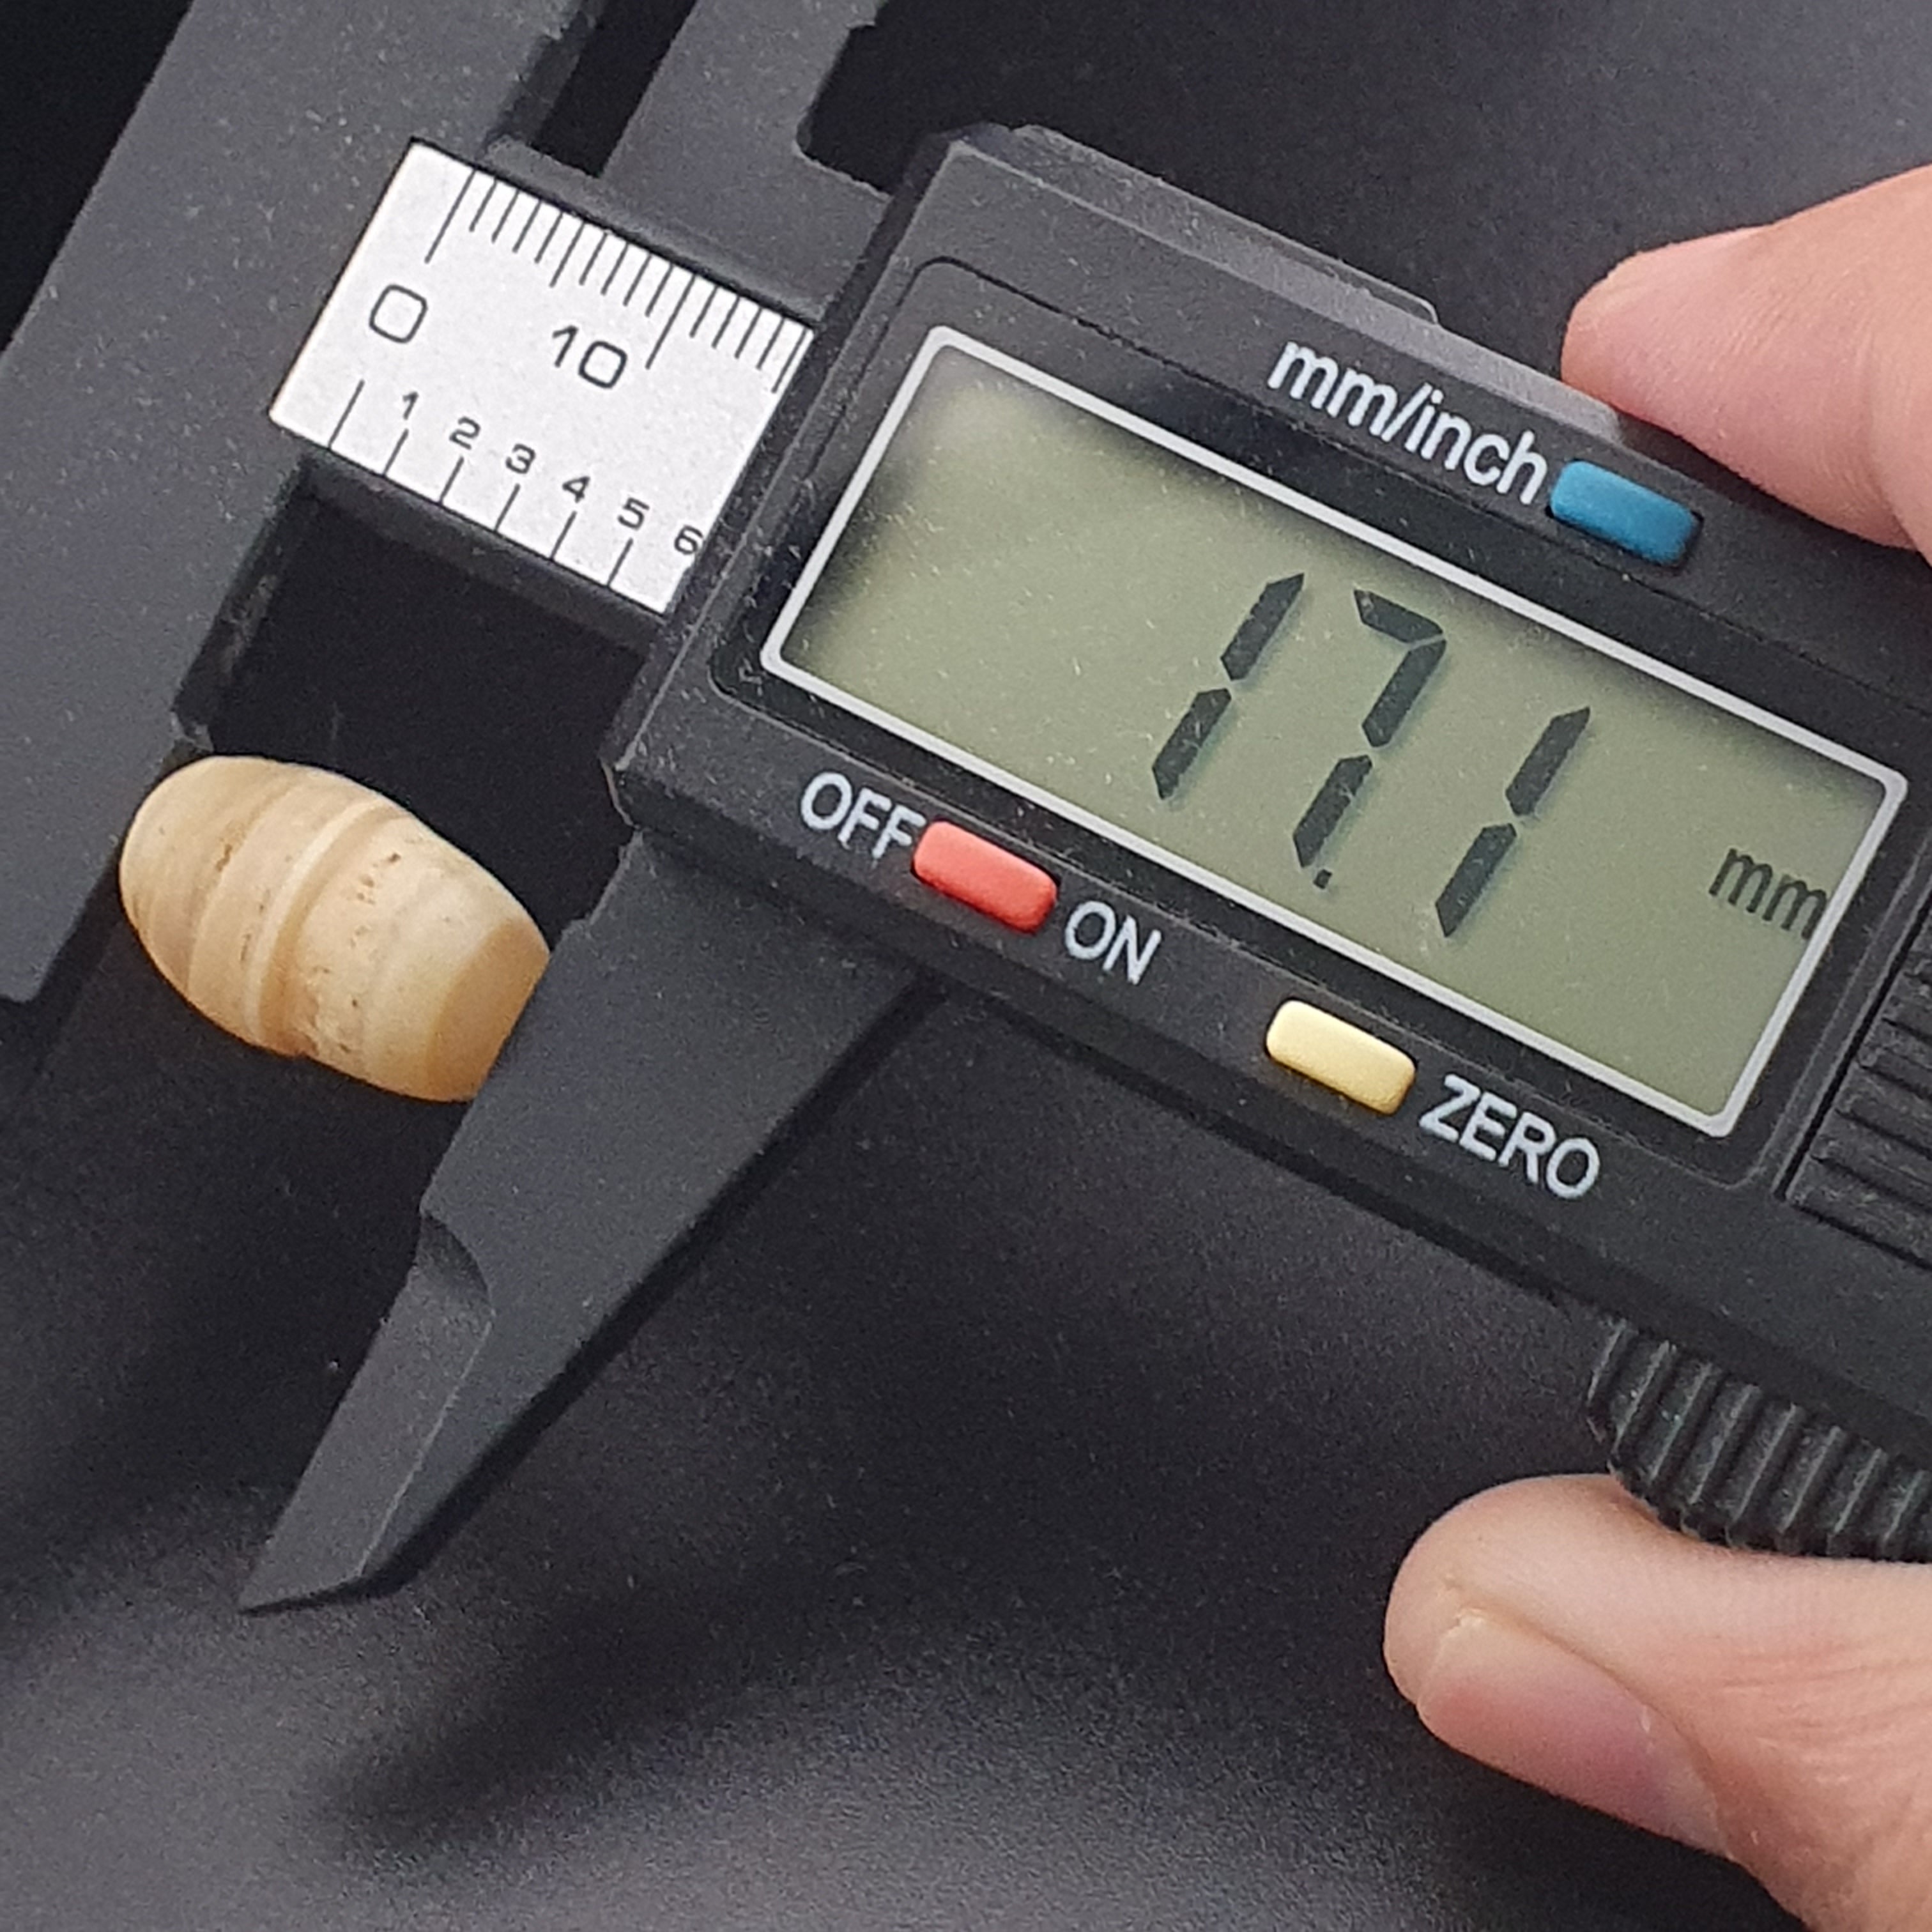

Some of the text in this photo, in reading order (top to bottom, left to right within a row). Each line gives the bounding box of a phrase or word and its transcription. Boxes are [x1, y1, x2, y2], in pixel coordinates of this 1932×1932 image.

[369, 284, 627, 388] 0 10
[402, 392, 703, 555] 1 2 3 4 5 6
[1268, 340, 1547, 504] mm/inch
[800, 772, 926, 859] OFF
[1151, 572, 1828, 940] 17.1 mm
[1064, 901, 1162, 984] ON
[1418, 1074, 1601, 1199] ZERO
